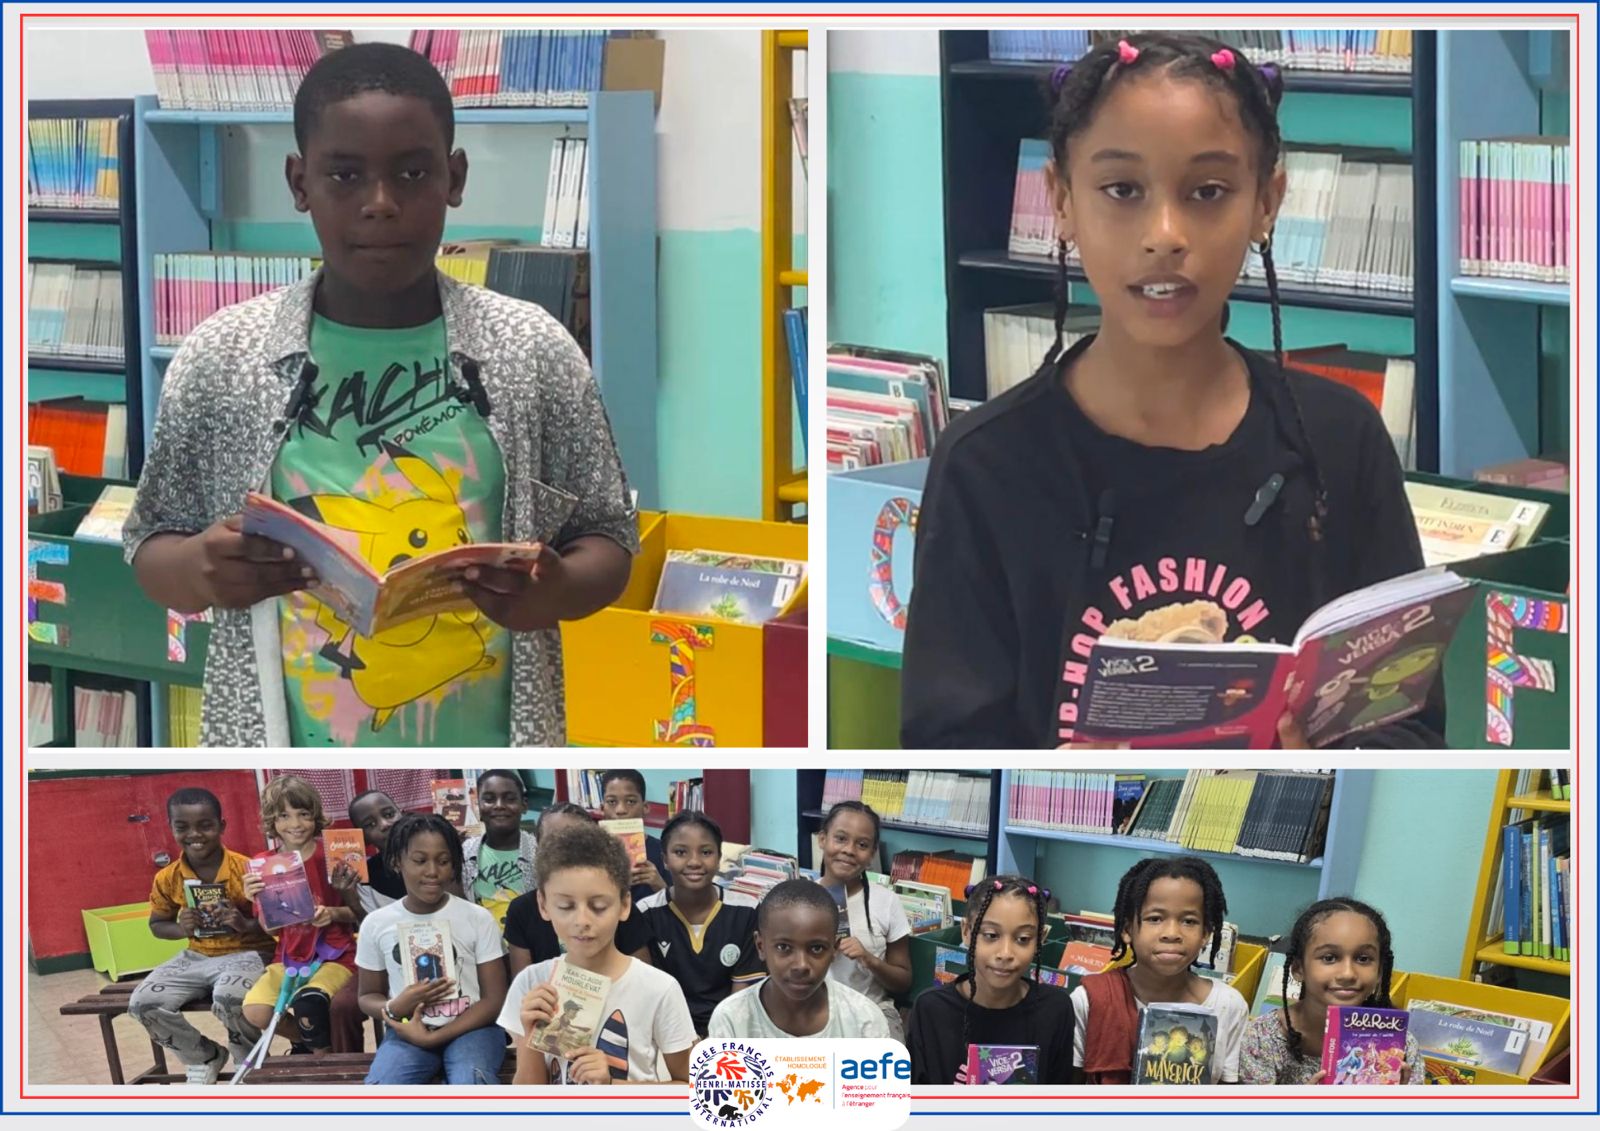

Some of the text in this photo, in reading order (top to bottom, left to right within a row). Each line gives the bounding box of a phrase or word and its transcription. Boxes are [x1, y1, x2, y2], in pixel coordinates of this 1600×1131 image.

[1517, 507, 1531, 520] E
[1490, 529, 1505, 543] E
[699, 573, 710, 582] La
[711, 574, 729, 585] robe
[730, 577, 740, 586] de
[1108, 557, 1270, 632] FASHION
[1402, 605, 1435, 632] 2
[1136, 655, 1159, 673] 2
[1486, 589, 1568, 747] F
[651, 620, 714, 747] I
[194, 886, 223, 898] Beast
[220, 975, 254, 990] 976
[1448, 1021, 1465, 1031] robe
[1465, 1024, 1475, 1032] de
[1475, 1027, 1494, 1037] Noël
[1010, 1052, 1026, 1070] 2
[987, 1063, 1012, 1077] VERSA
[1145, 1059, 1205, 1085] MAVERICK
